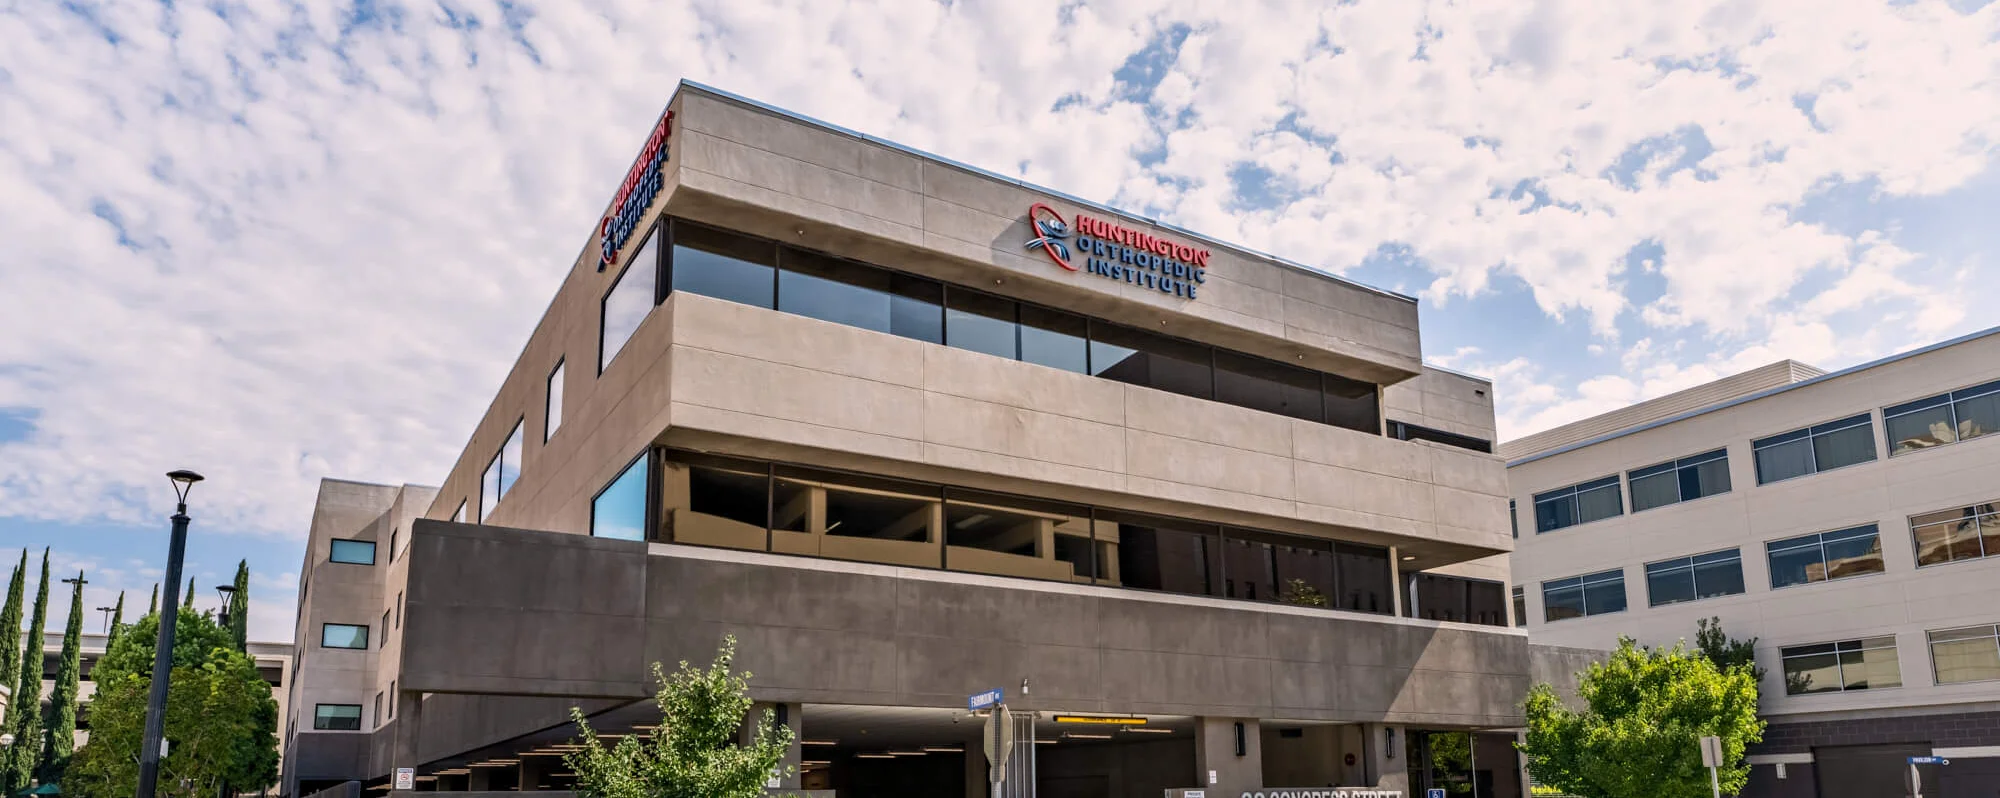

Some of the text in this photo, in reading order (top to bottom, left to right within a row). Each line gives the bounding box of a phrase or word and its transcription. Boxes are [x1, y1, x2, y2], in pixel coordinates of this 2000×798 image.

[613, 142, 669, 233] ORTHOPEDIC
[614, 111, 673, 216] HUNTINGTON
[615, 171, 664, 250] INSTITUTE
[1076, 214, 1210, 267] HUNTINGTON
[1077, 236, 1206, 284] ORTHOPEDIC
[1088, 257, 1197, 299] INSTITUTE
